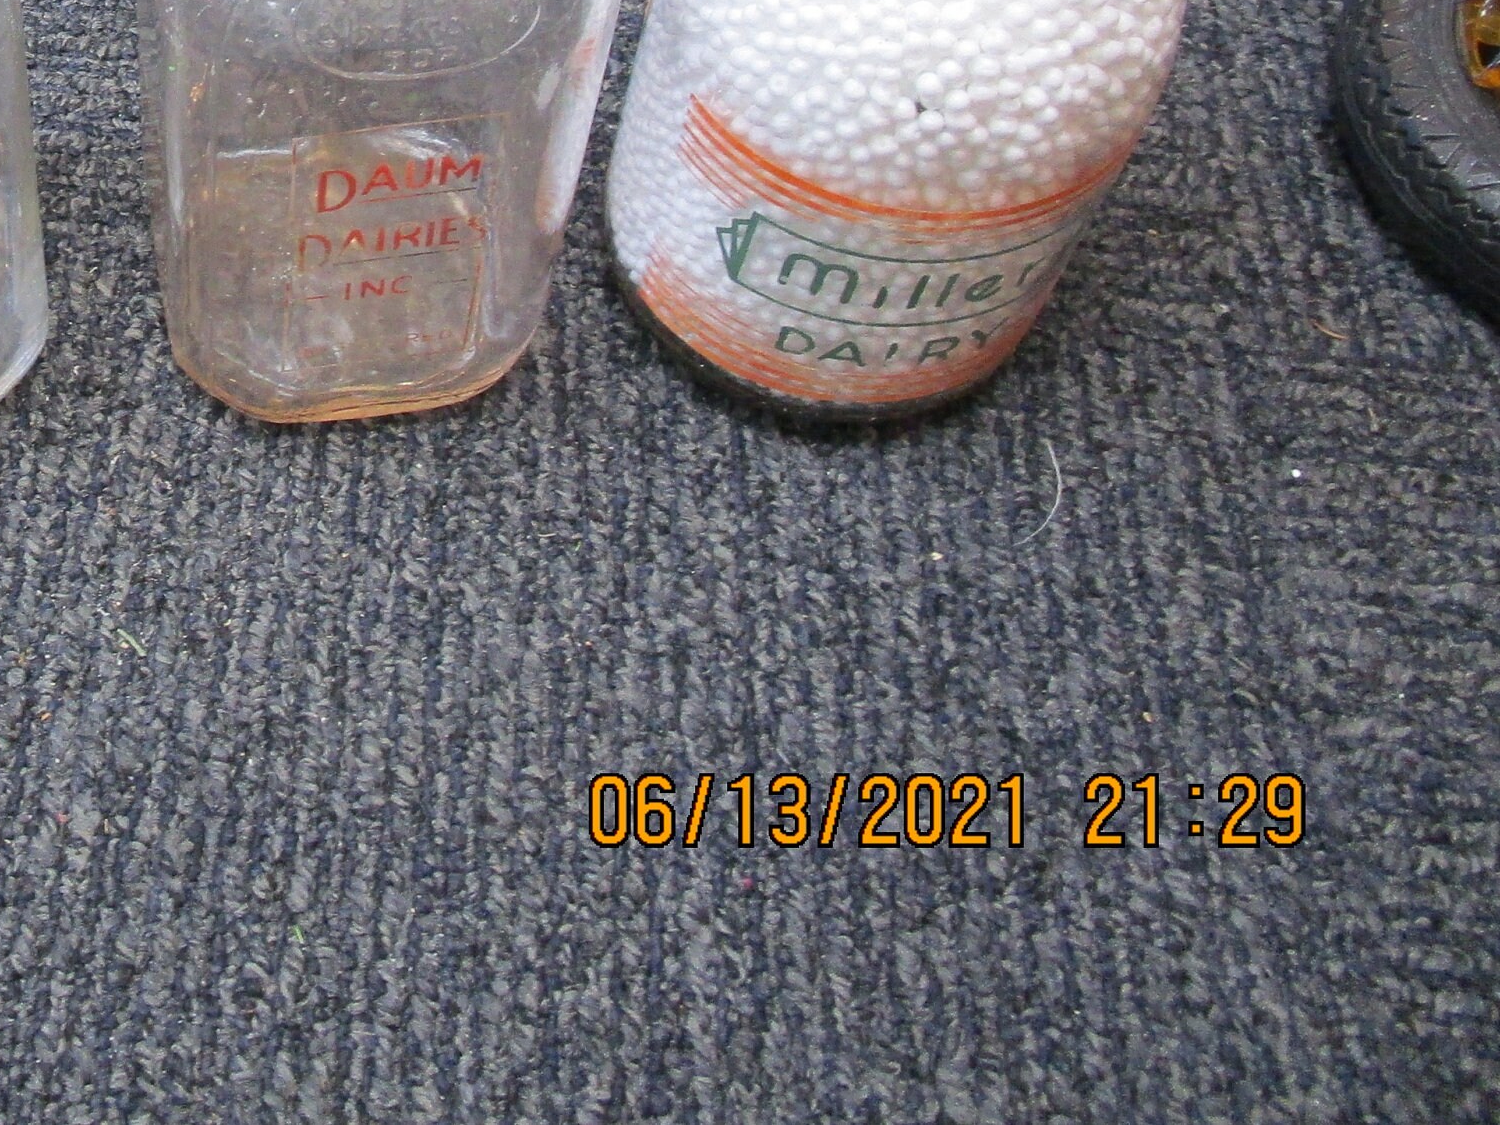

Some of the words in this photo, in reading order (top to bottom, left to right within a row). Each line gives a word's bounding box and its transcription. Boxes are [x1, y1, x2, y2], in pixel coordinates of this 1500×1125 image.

[315, 152, 486, 214] DAUM
[298, 216, 488, 271] DAIRIES
[344, 275, 413, 301] INC
[773, 315, 1014, 368] DAIRY
